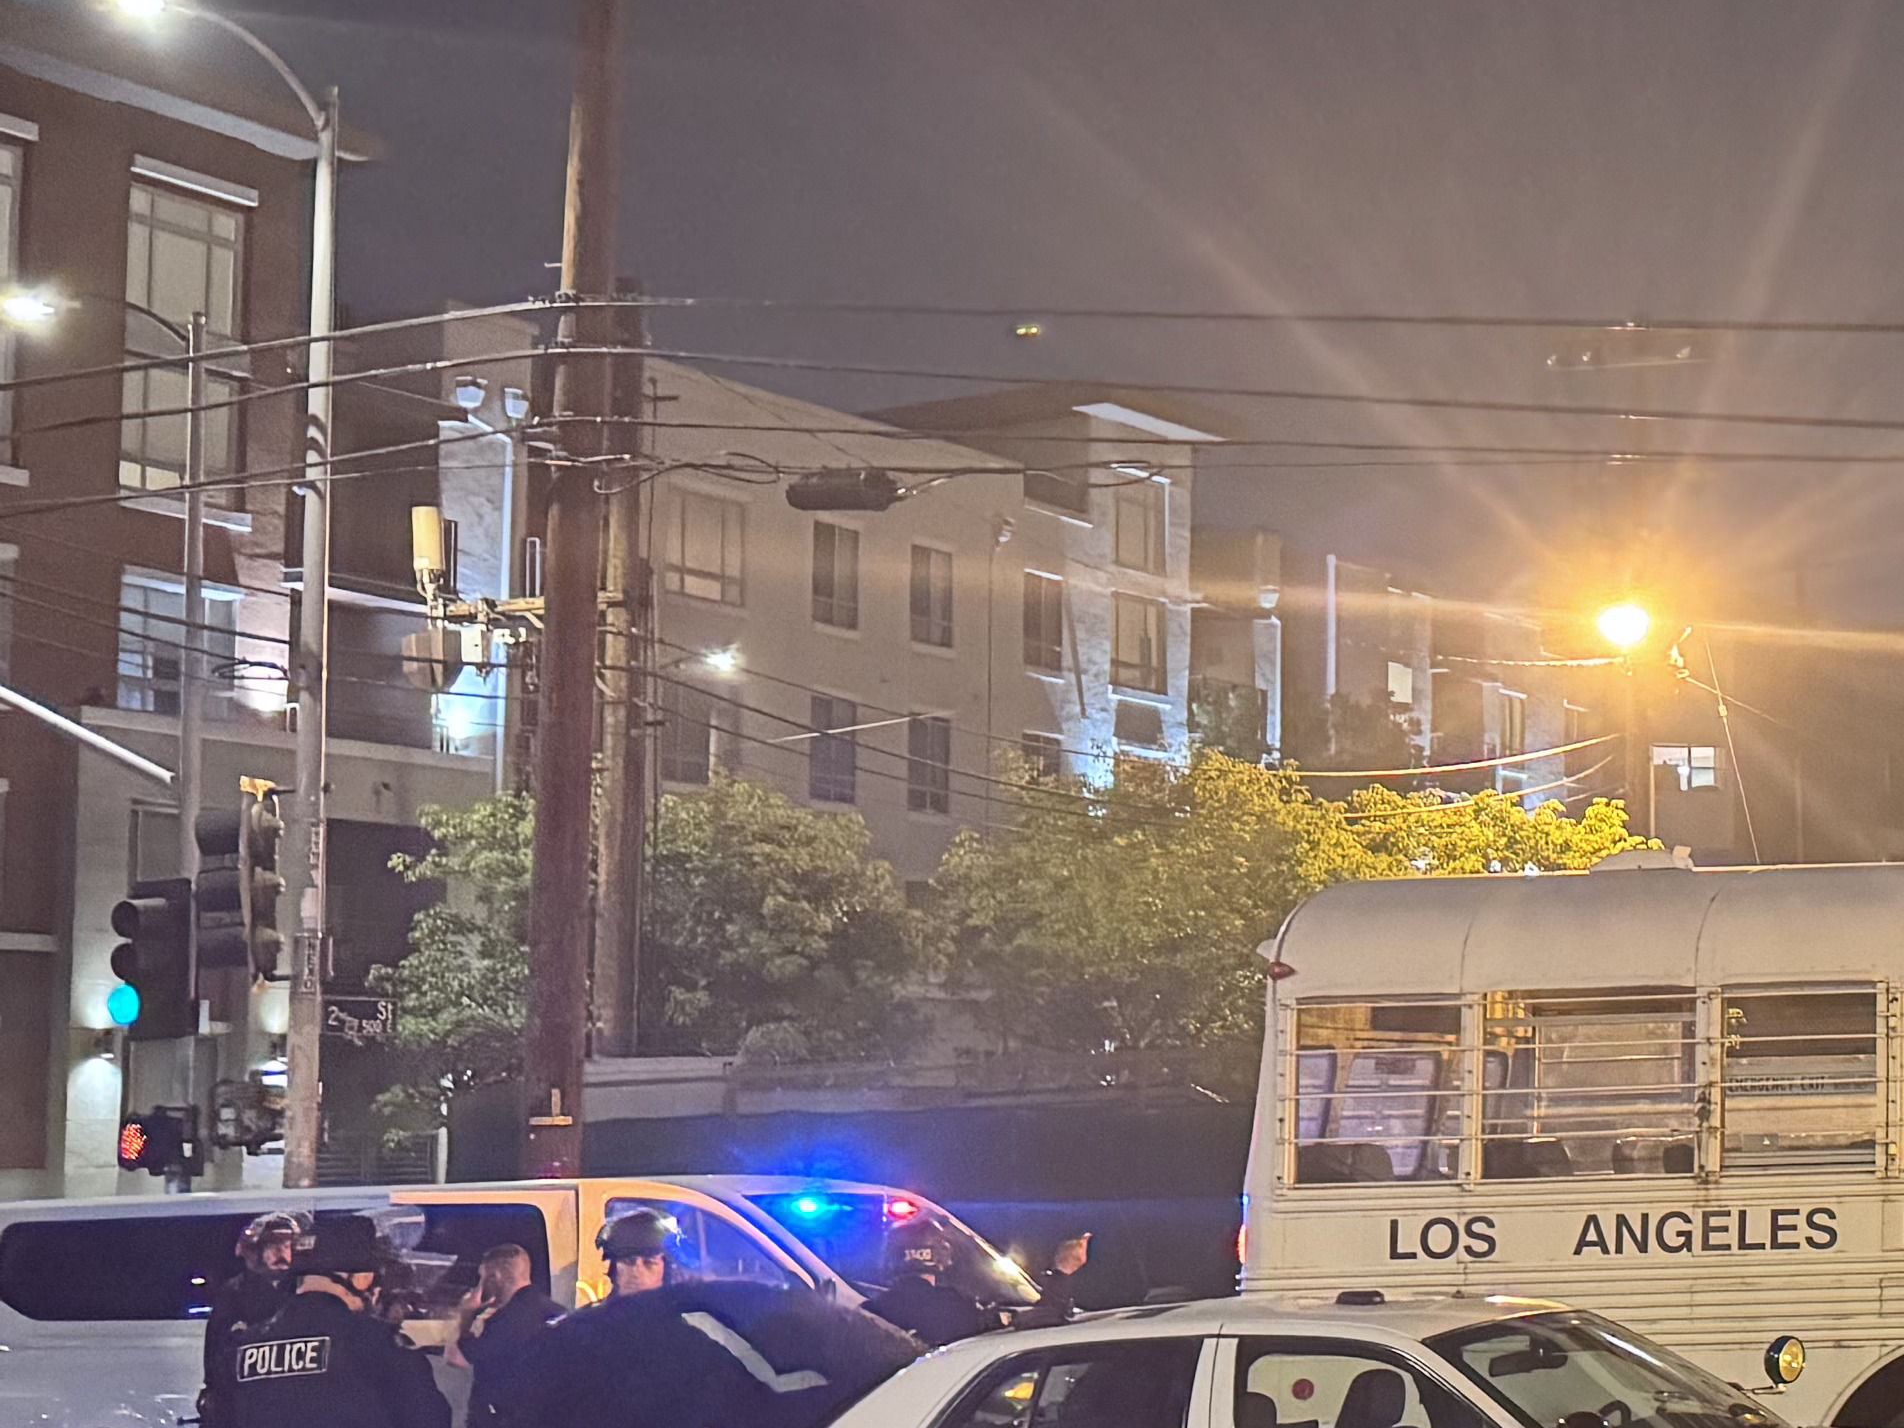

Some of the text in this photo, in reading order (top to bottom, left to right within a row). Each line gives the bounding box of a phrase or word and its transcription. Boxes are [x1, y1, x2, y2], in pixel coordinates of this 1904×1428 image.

[377, 1001, 394, 1021] St
[1728, 1076, 1795, 1092] EMERGENCY
[1388, 1215, 1498, 1260] LOS
[1573, 1207, 1839, 1256] ANGELES
[244, 1341, 320, 1377] POLICE
